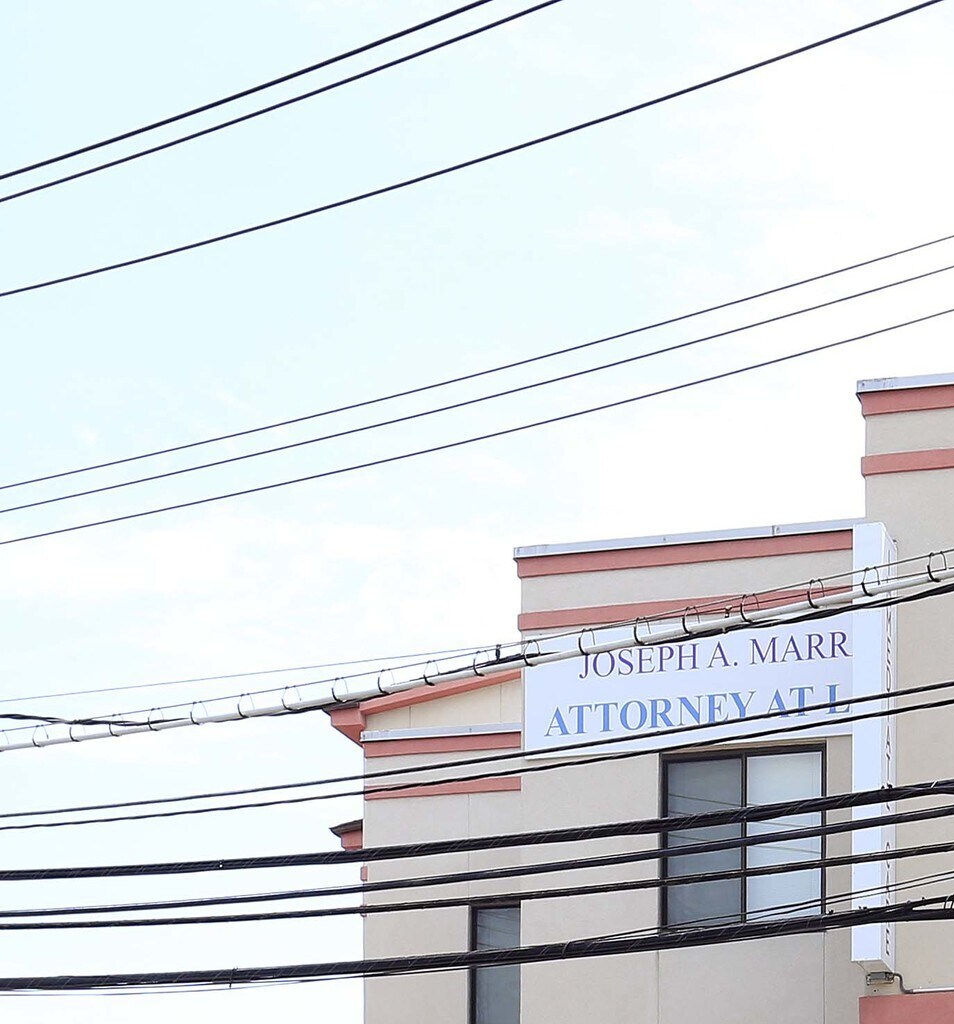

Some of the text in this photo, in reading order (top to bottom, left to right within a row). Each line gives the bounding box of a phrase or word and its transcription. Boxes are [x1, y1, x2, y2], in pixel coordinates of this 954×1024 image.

[579, 631, 853, 679] JOSEPH A. MARR
[544, 683, 851, 737] ATTORNEY AT L
